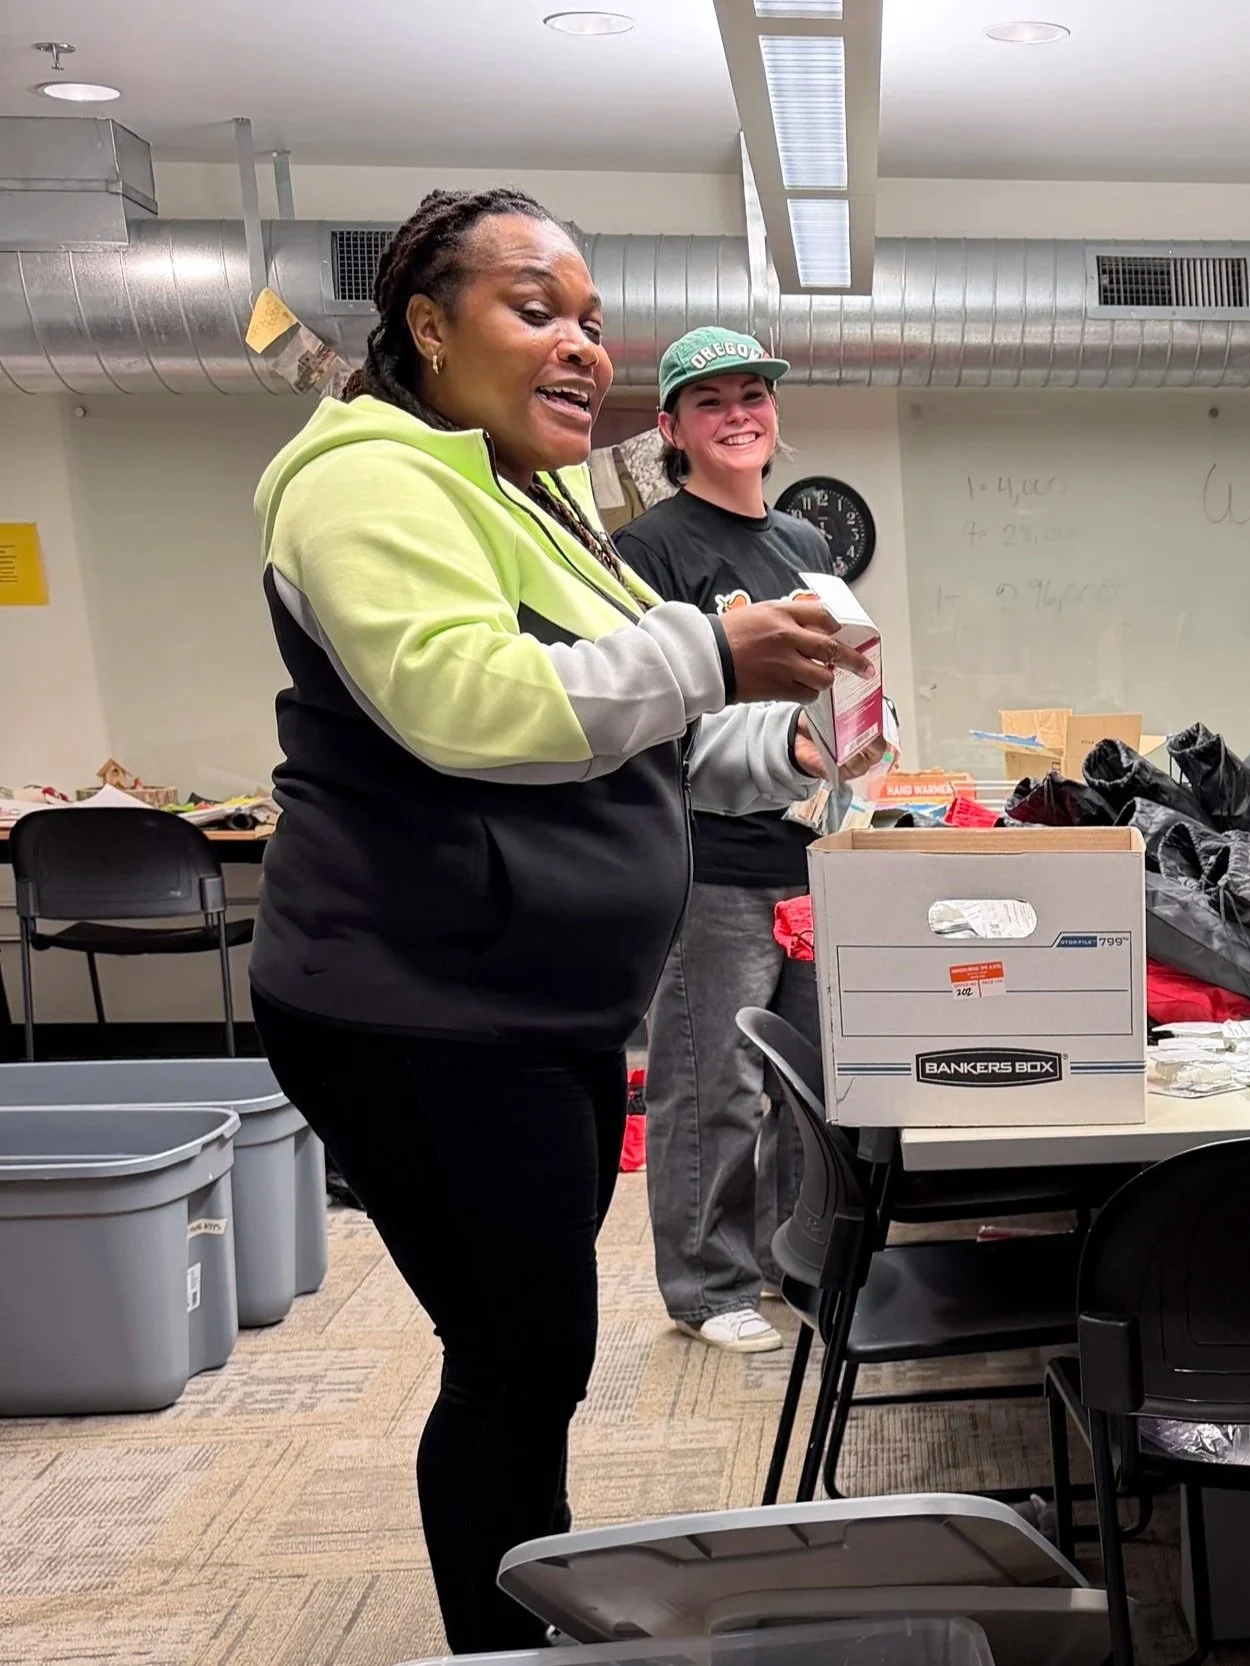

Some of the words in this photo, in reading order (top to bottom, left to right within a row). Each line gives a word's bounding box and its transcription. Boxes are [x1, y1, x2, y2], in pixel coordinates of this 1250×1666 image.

[846, 511, 857, 525] 2
[846, 545, 856, 558] 4
[925, 1061, 1012, 1075] BANKERS
[1015, 1060, 1054, 1074] BOX
